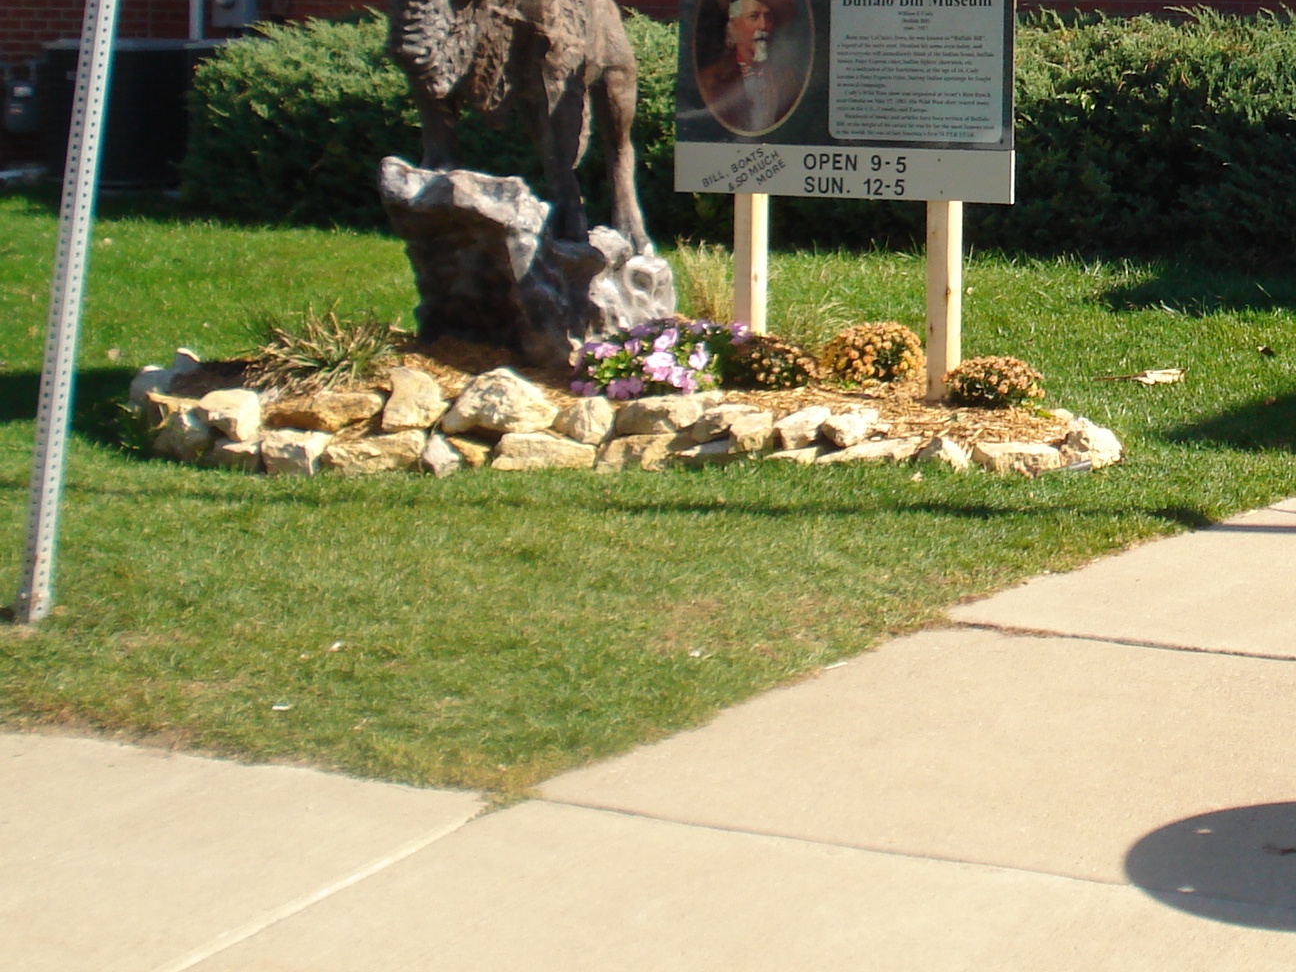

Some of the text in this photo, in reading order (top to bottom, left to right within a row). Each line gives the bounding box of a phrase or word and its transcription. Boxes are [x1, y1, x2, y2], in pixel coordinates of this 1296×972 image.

[731, 148, 764, 172] BOATS
[735, 173, 750, 187] SO
[749, 150, 780, 177] MUCH
[756, 159, 787, 185] MORE
[803, 153, 858, 172] OPEN
[804, 176, 905, 195] SUN. 12-5
